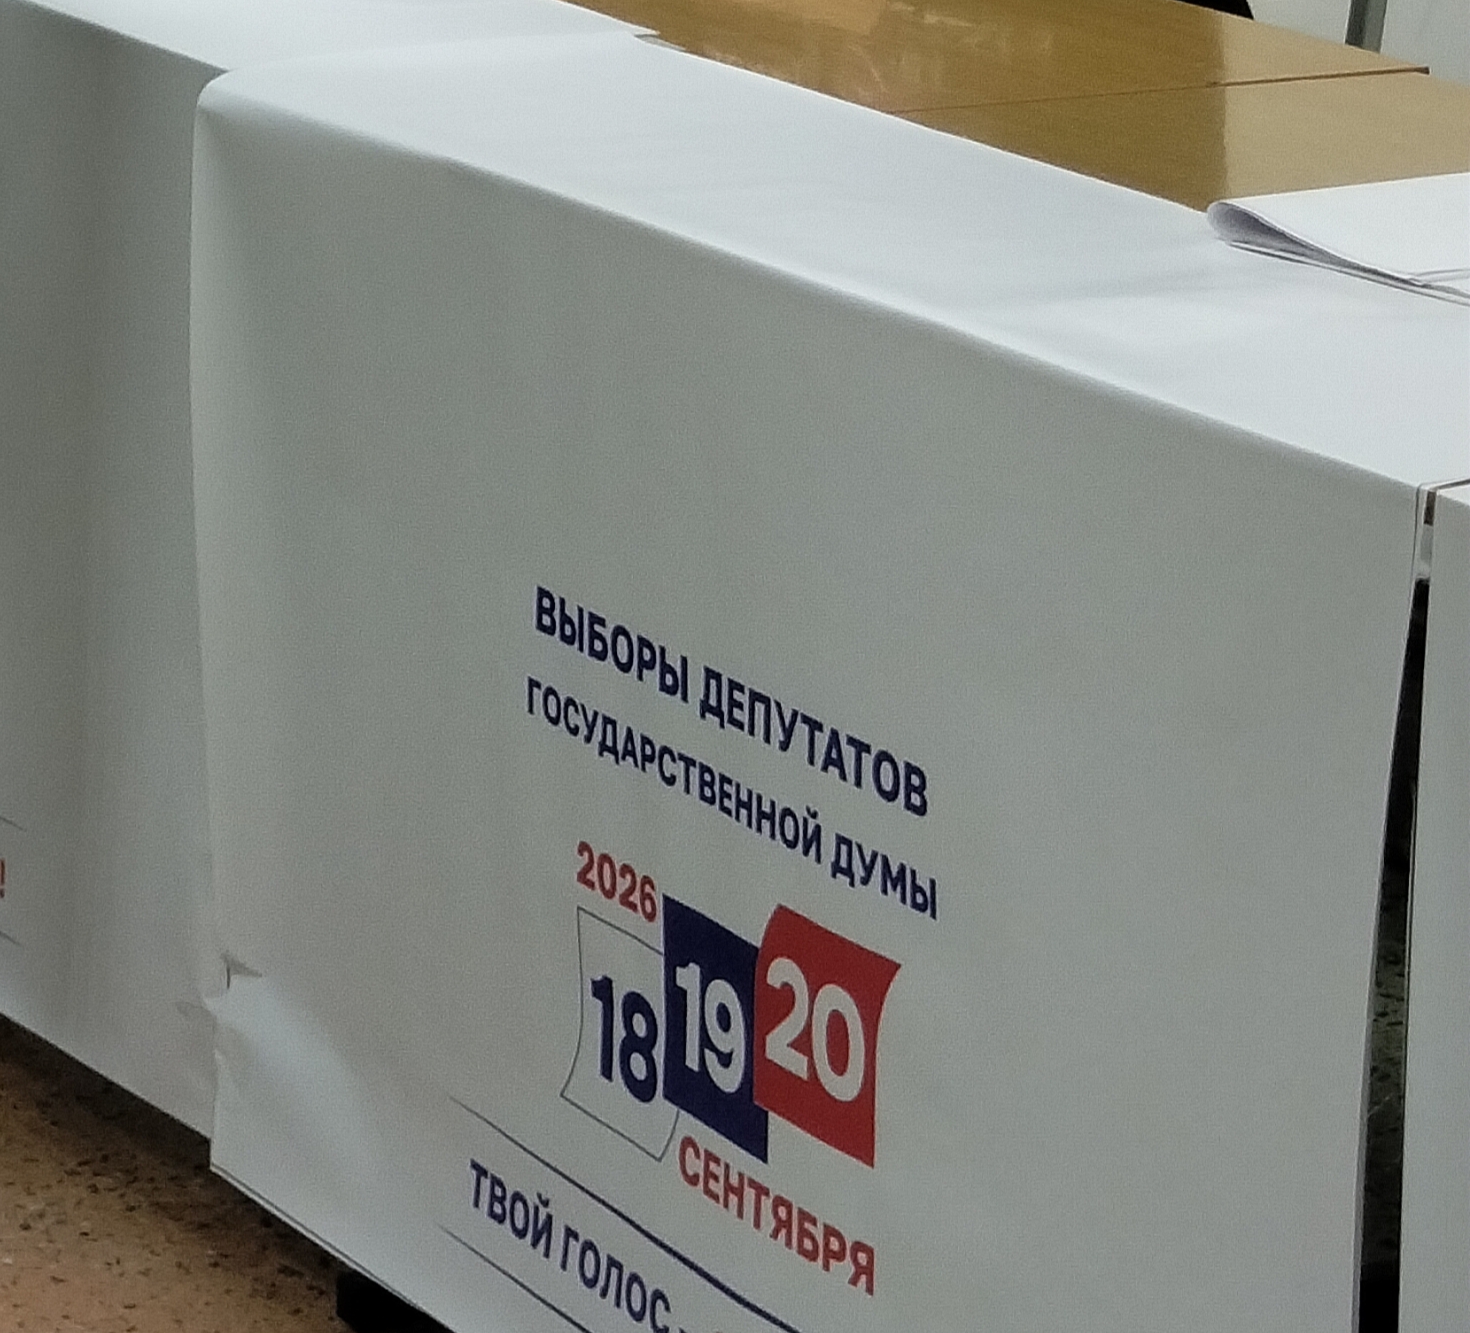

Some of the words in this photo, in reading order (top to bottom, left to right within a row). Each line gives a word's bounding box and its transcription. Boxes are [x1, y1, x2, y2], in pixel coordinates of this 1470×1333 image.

[535, 585, 689, 704] ВЫБОРЫ
[699, 664, 928, 817] ДЕПУТАТОВ
[527, 675, 822, 865] ГОСУДАРСТВЕННОЙ
[831, 832, 938, 921] ДУМЫ
[576, 839, 658, 923] 2026
[590, 974, 658, 1103] 18
[675, 961, 746, 1095] 19
[765, 955, 866, 1103] 20
[470, 1157, 554, 1259] ТВОЙ
[560, 1224, 672, 1333] ГОЛОС
[678, 1134, 876, 1297] СЕНТЯБРЯ
